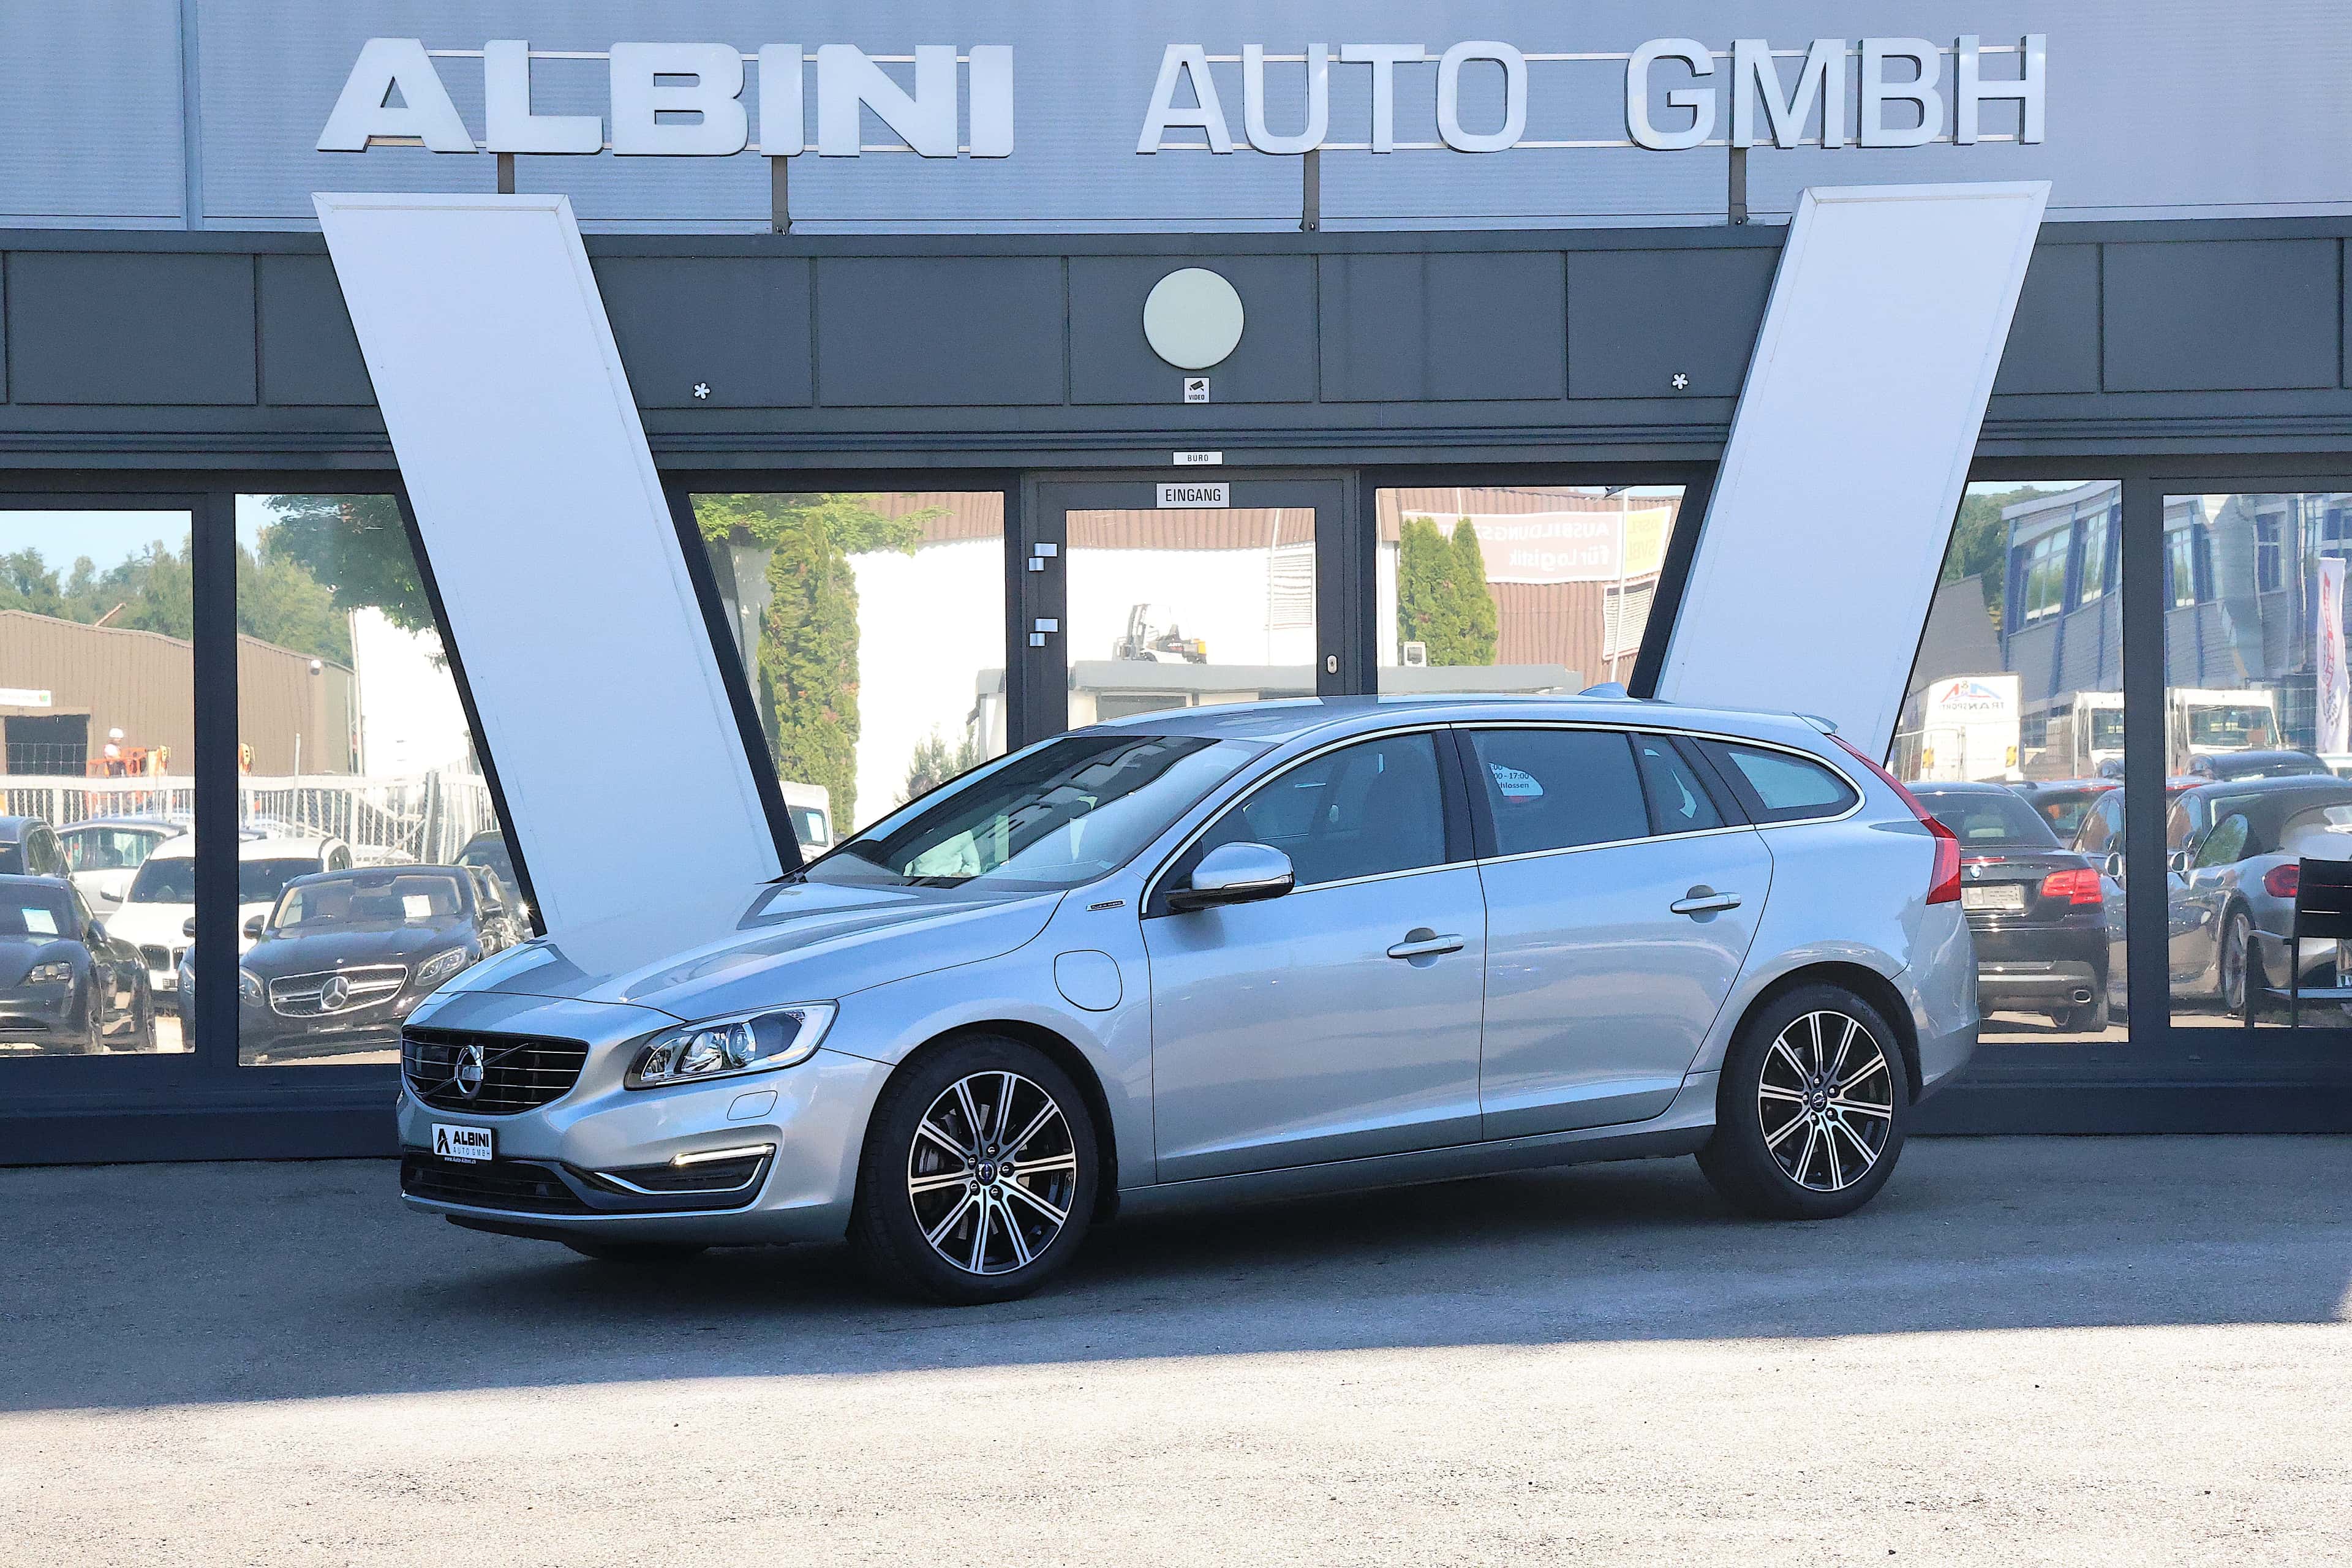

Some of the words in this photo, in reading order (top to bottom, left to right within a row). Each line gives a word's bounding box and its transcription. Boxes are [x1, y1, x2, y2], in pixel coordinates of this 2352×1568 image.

[315, 37, 1014, 158] ALBINI
[1136, 39, 1529, 154] AUTO
[1626, 33, 2047, 152] GMBH
[1165, 488, 1221, 502] EINGANG
[453, 1131, 489, 1148] ALBINI
[453, 1146, 470, 1156] AUTO
[472, 1148, 490, 1157] GMBH
